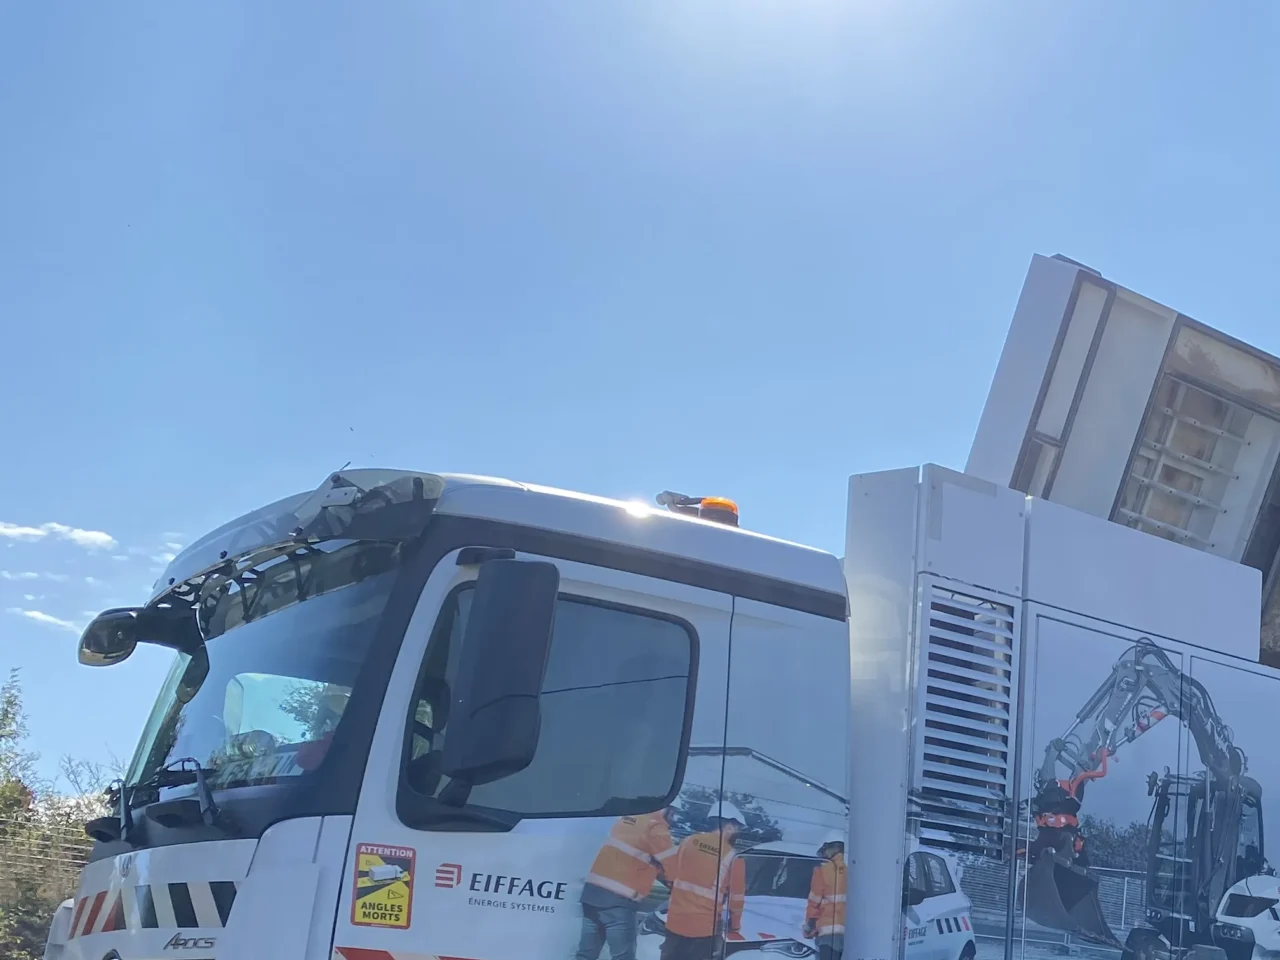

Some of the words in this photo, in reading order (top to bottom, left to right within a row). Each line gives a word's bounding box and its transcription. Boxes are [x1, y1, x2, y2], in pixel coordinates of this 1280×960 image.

[360, 845, 413, 858] ATTENTION
[469, 872, 568, 901] EIFFAGE
[361, 901, 403, 913] ANGLES
[362, 911, 400, 922] MORTS
